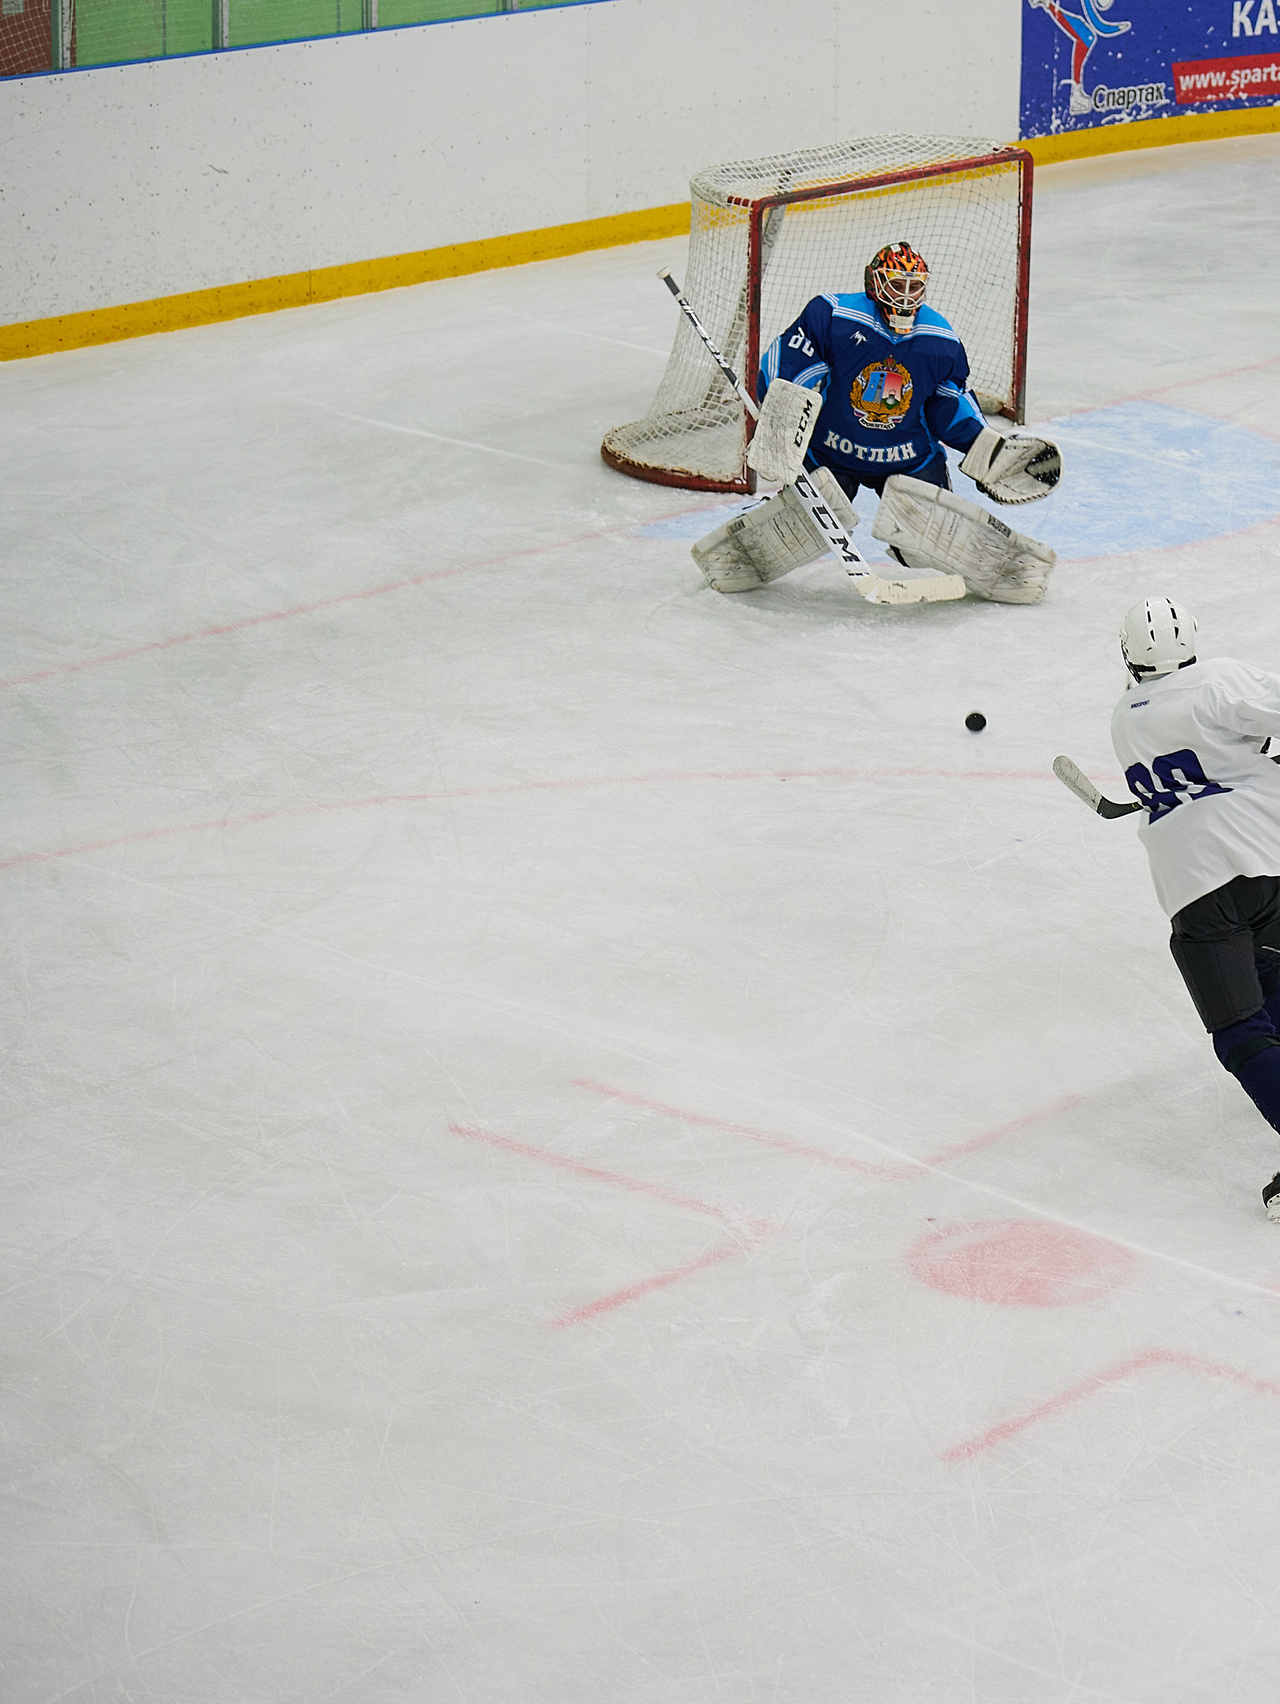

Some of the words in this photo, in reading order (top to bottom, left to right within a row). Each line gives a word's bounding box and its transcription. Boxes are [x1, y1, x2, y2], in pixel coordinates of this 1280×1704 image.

[1093, 84, 1164, 110] Спартак
[794, 399, 813, 448] CCM
[823, 430, 917, 463] КОТЛИН
[794, 473, 861, 562] CCM
